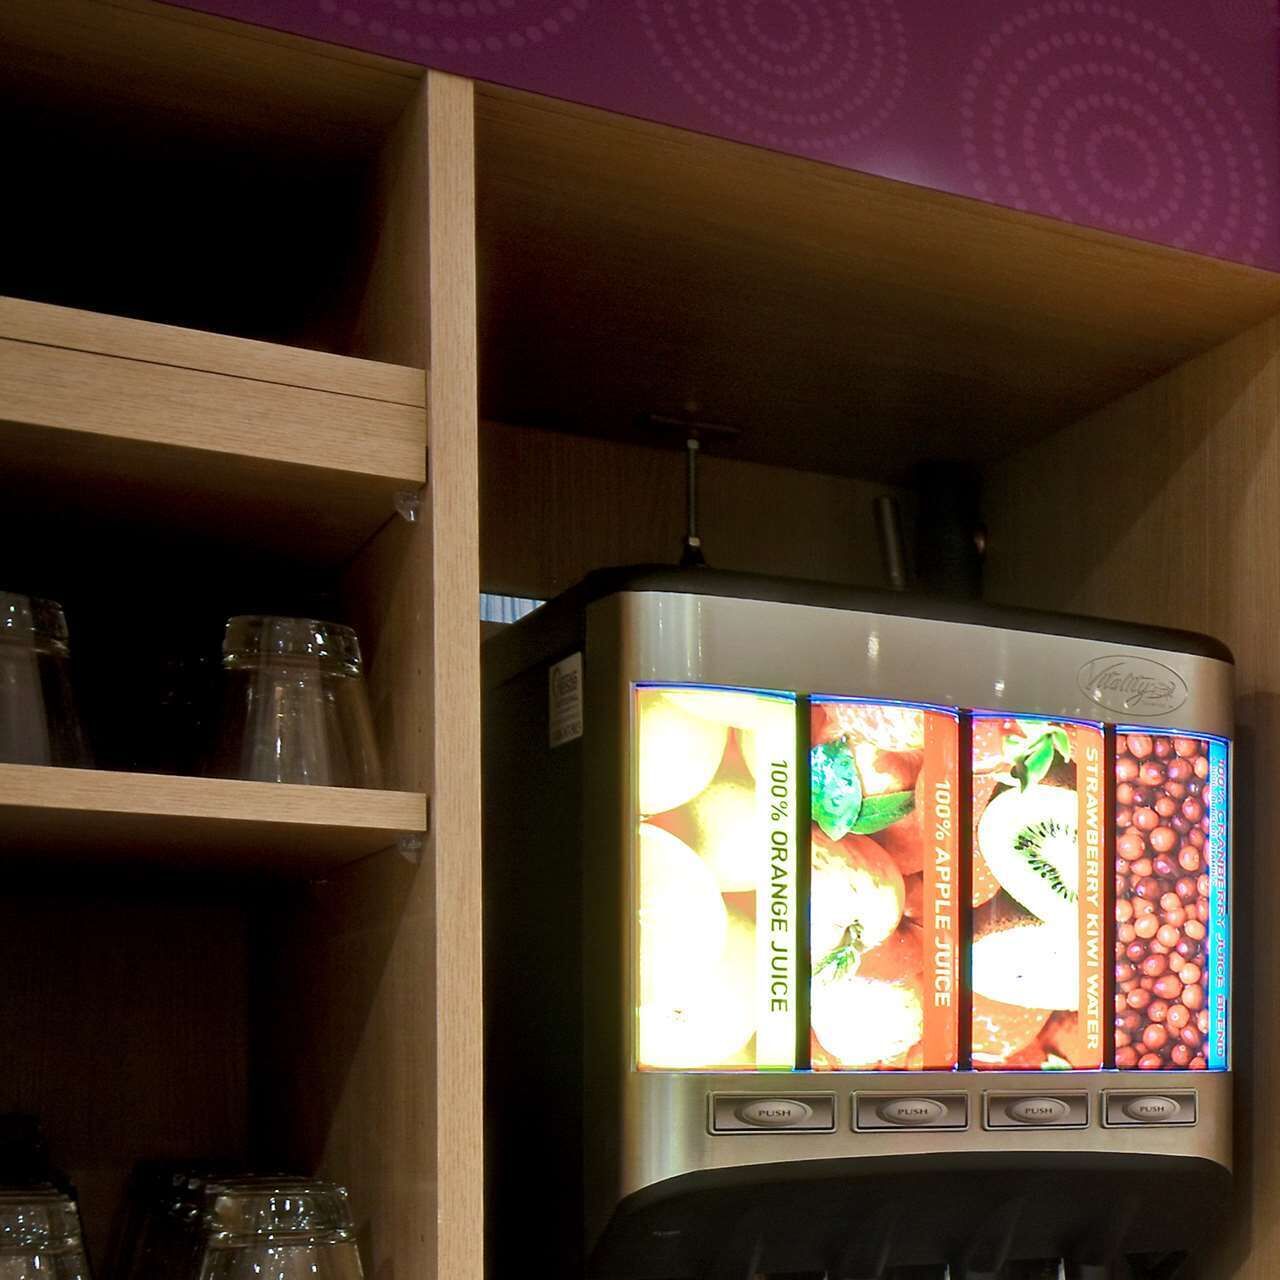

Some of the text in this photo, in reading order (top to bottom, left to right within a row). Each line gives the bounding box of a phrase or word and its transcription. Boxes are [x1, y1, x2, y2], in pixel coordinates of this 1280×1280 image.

[770, 759, 788, 1013] 100% ORANGE JUICE
[934, 781, 951, 1008] 100% APPLE JUICE
[1086, 747, 1100, 1050] STRAWBERRY KIWI WATER
[1216, 759, 1225, 1057] 100% CRANBERRY JUICE BLEND
[757, 1109, 791, 1118] PUSH
[896, 1107, 929, 1116] PUSH
[1023, 1106, 1054, 1115] PUSH
[1139, 1105, 1165, 1113] PUSH
